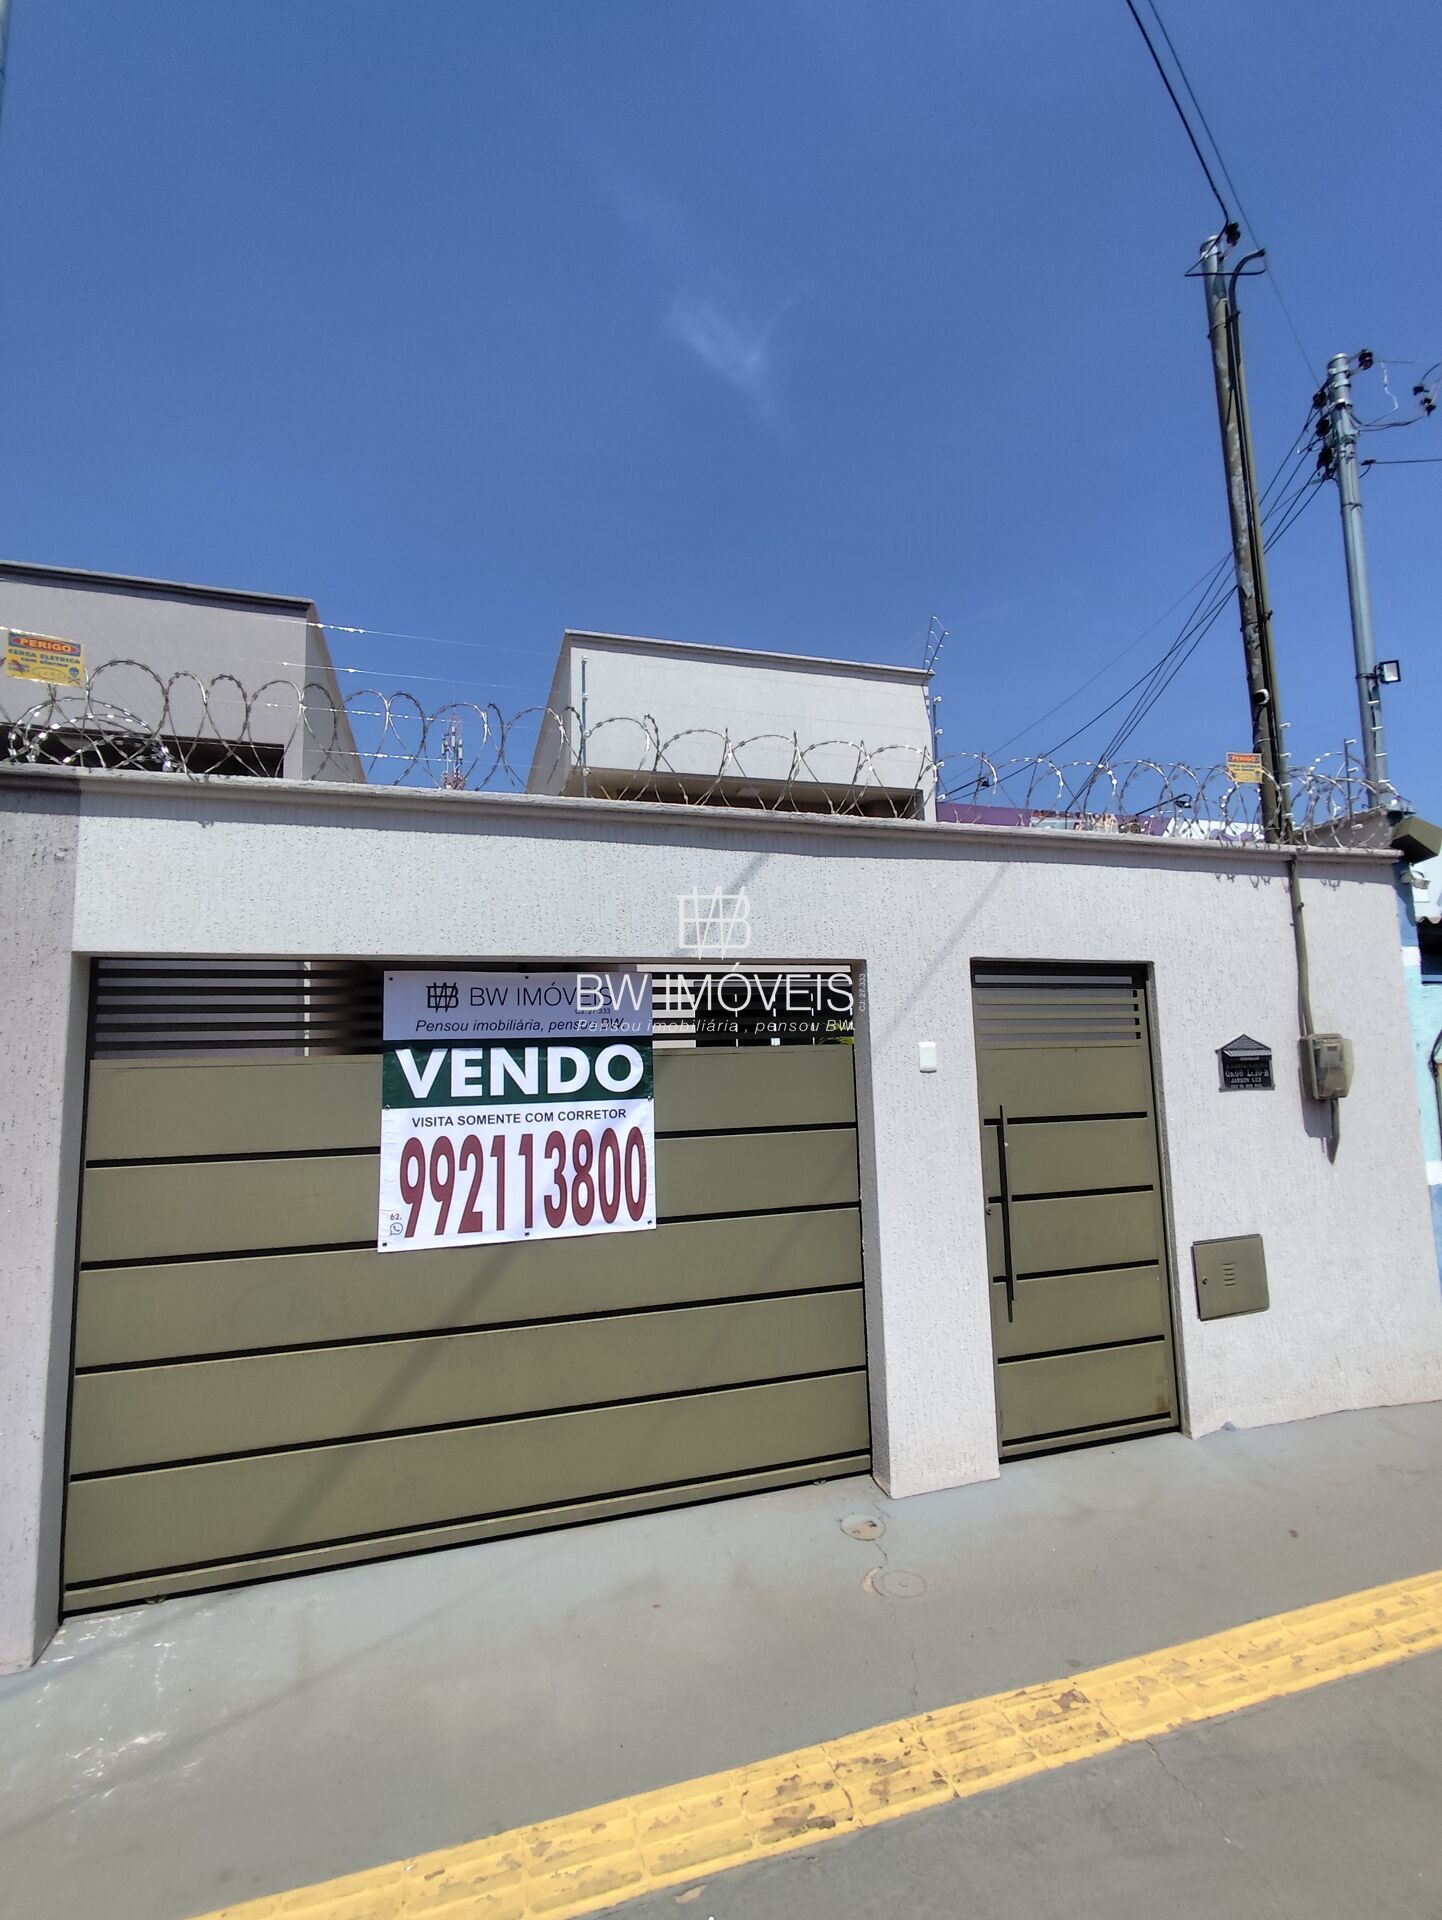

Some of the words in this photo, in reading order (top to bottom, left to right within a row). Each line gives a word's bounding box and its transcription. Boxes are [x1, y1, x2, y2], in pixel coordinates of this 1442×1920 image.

[8, 648, 37, 658] CERCA
[20, 637, 72, 652] PERIGO
[470, 987, 508, 1007] BW
[517, 982, 612, 1006] IMÓVEIS
[415, 1019, 469, 1032] Pensou
[473, 1018, 544, 1033] imobiliária,
[394, 1044, 645, 1099] VENDO
[412, 1115, 454, 1128] VISITA
[457, 1113, 521, 1126] SOMENTE
[525, 1111, 554, 1123] COM
[557, 1108, 627, 1122] CORRETOR
[400, 1126, 647, 1239] 992113800
